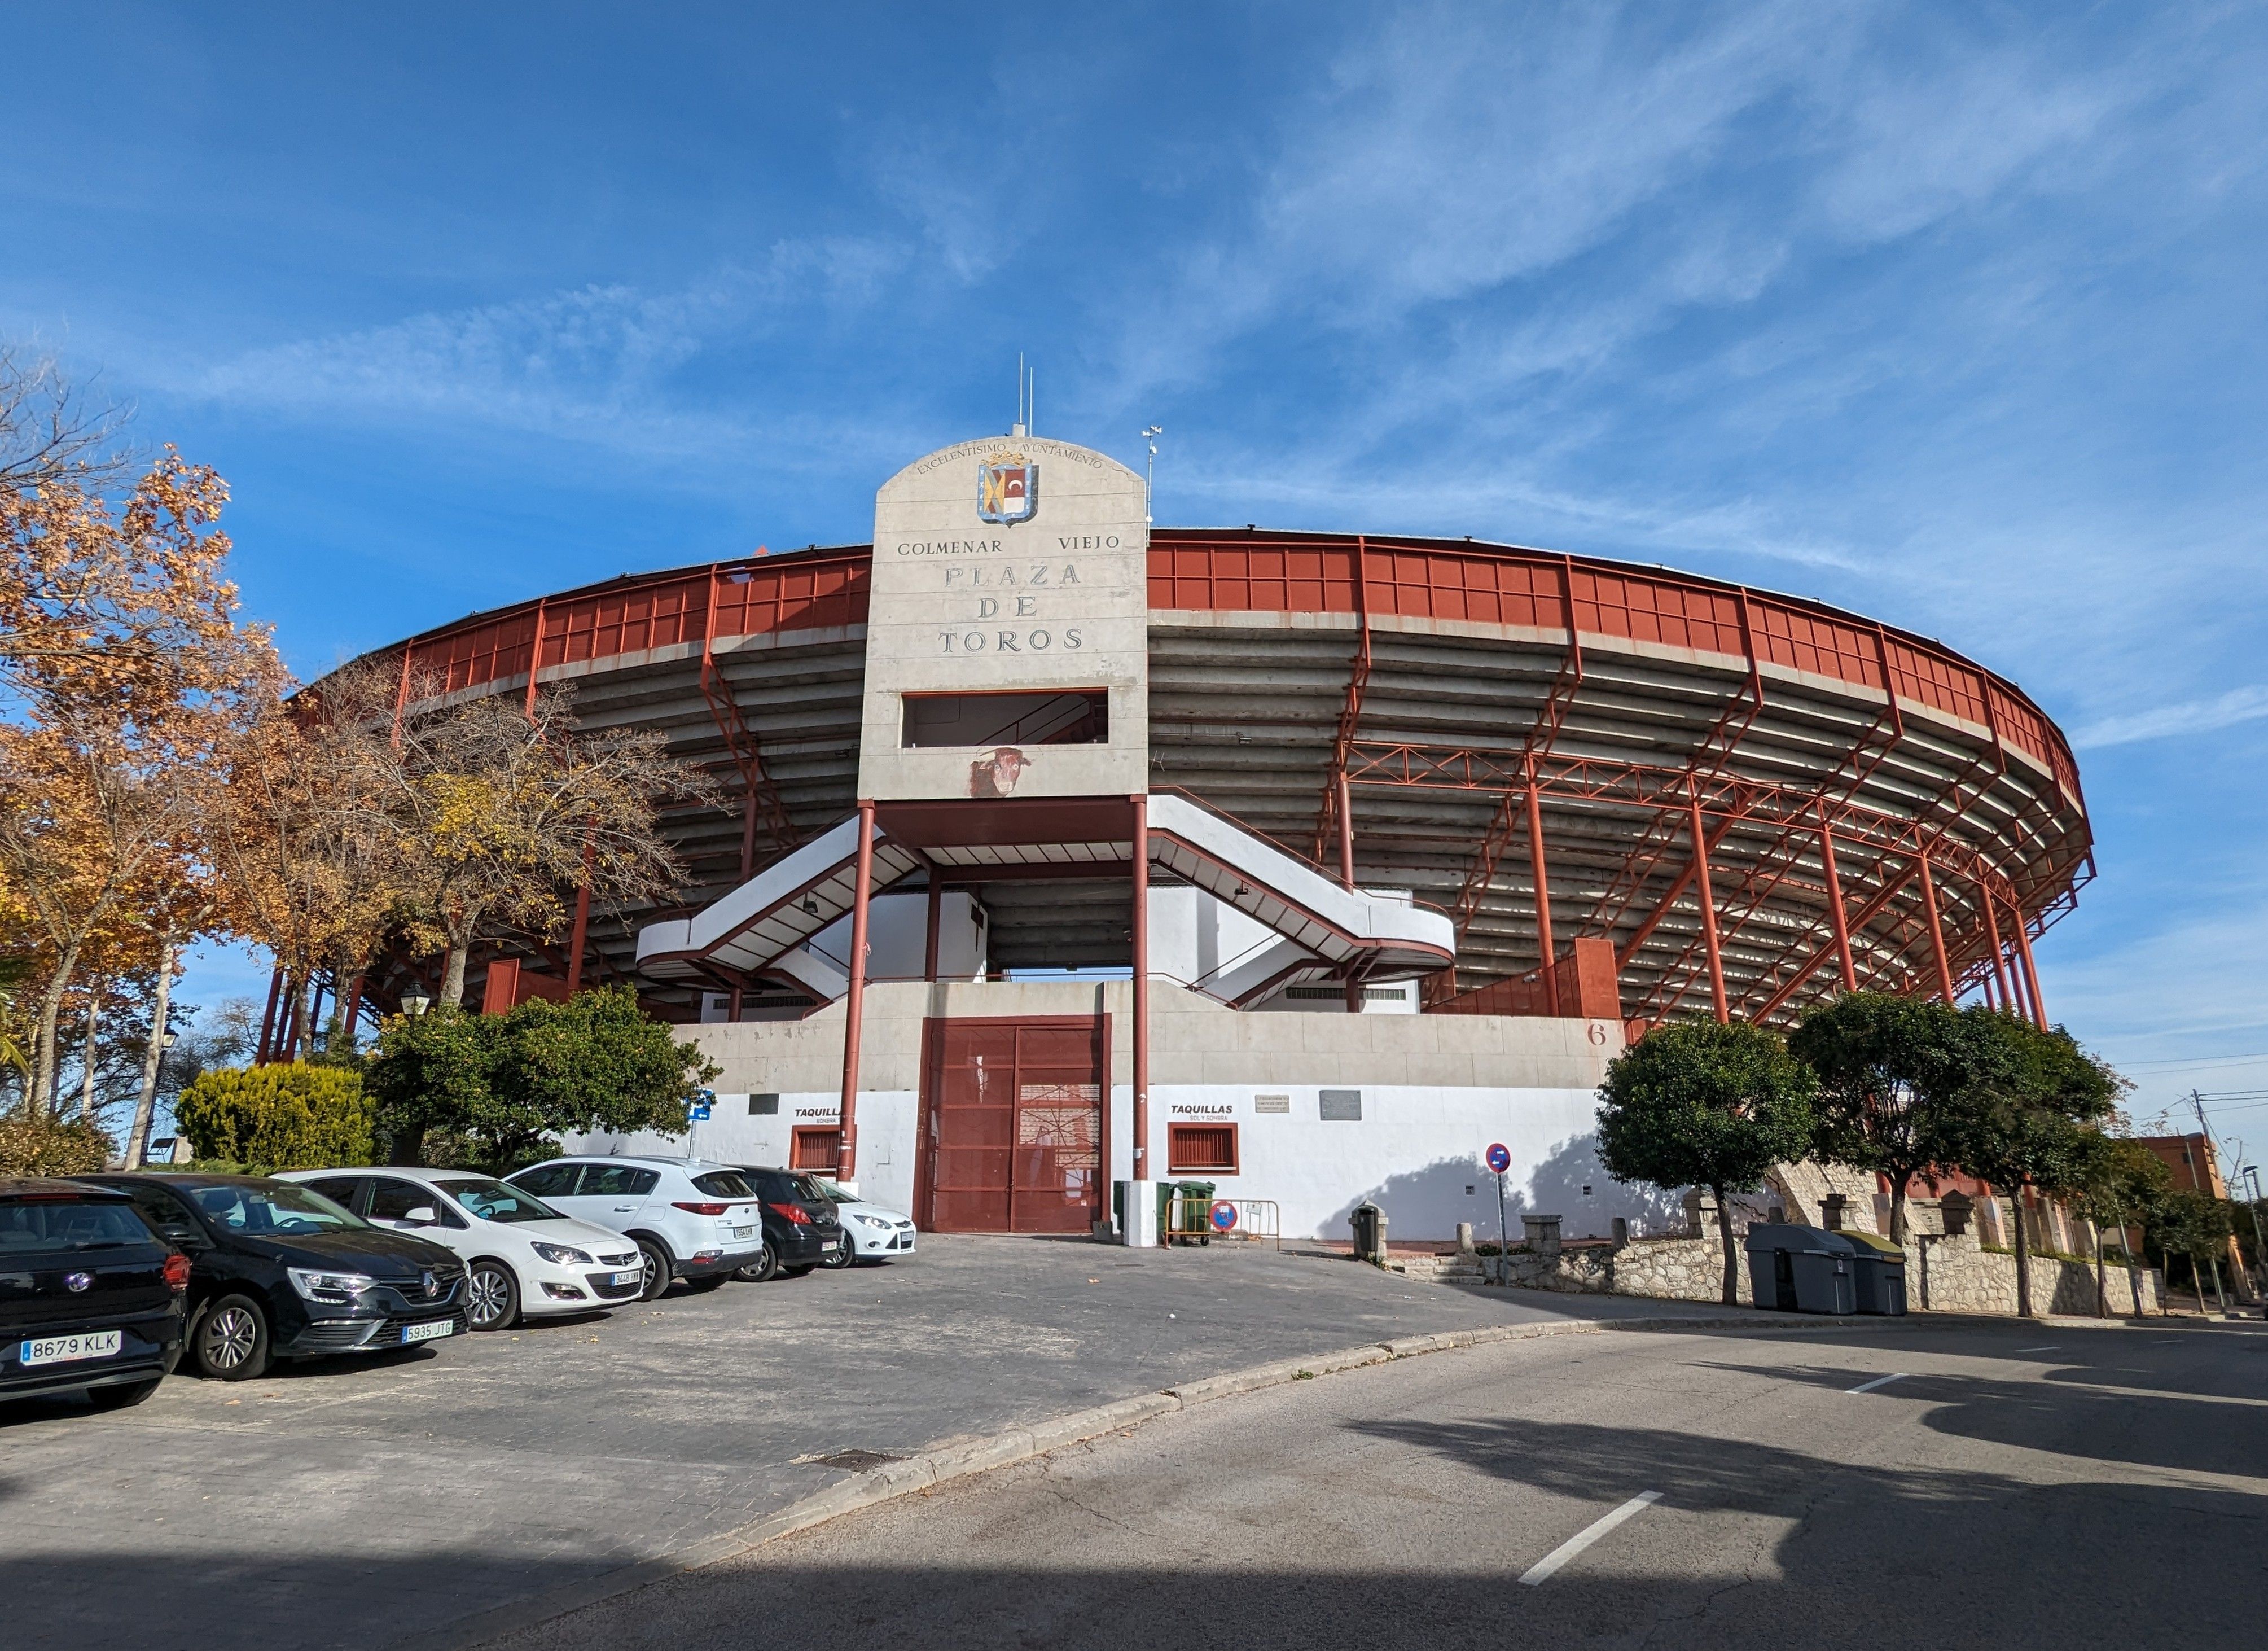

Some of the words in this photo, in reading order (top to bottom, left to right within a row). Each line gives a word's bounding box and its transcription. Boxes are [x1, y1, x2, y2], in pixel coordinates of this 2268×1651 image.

[917, 444, 1006, 474] EXCELENTISIMO
[1019, 444, 1102, 469] AYUNTAMIENTO
[897, 540, 1003, 555] COLMENAR
[1058, 536, 1119, 550] VIEJO
[945, 564, 1081, 588] PLAZA
[978, 596, 1037, 618] DE
[938, 628, 1082, 653] TOROS
[1587, 1024, 1606, 1046] 6
[795, 1107, 840, 1117] TAQUILL
[1171, 1105, 1233, 1114] TAQUILLAS
[409, 1325, 431, 1339] 5935
[435, 1322, 451, 1335] JTG
[33, 1339, 78, 1358] 8679
[85, 1334, 116, 1351] KLK
